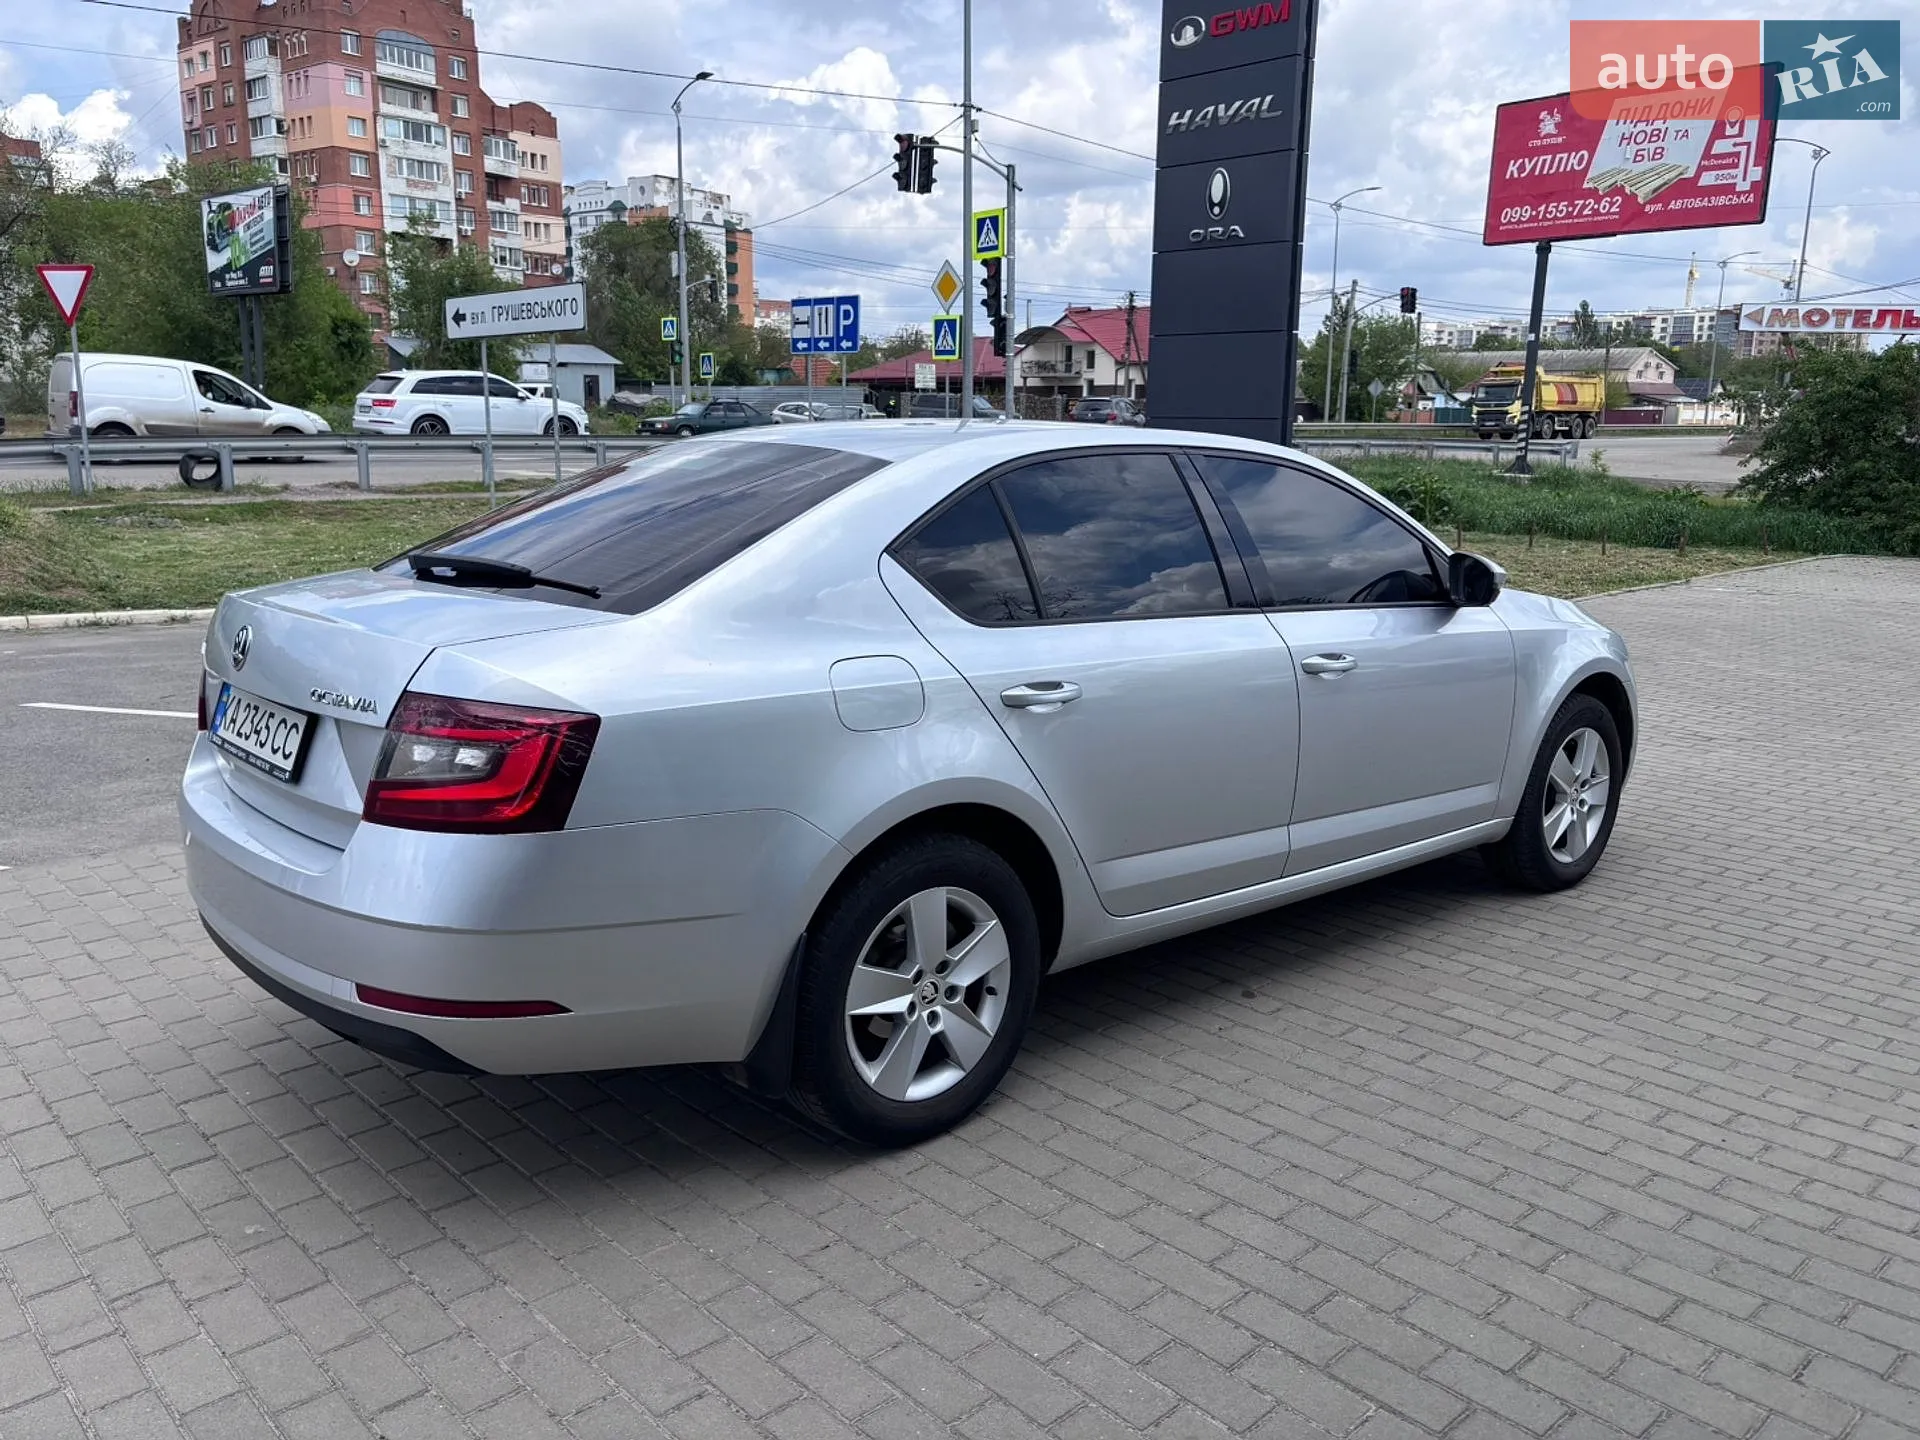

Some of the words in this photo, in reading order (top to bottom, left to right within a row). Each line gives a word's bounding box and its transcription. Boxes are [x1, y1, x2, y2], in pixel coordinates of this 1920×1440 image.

[1209, 0, 1291, 37] GWM
[1165, 94, 1283, 134] HAVAL
[1618, 127, 1669, 147] НОВІ
[1505, 149, 1589, 180] КУПЛЮ
[1668, 193, 1755, 211] АВТОБАЗІВСЬКА
[1189, 225, 1245, 242] ORA
[491, 297, 579, 323] ГРУШЕВСЬКОГО
[1766, 307, 1920, 330] МОТЕЛЬ
[310, 687, 378, 714] OCTAVIA
